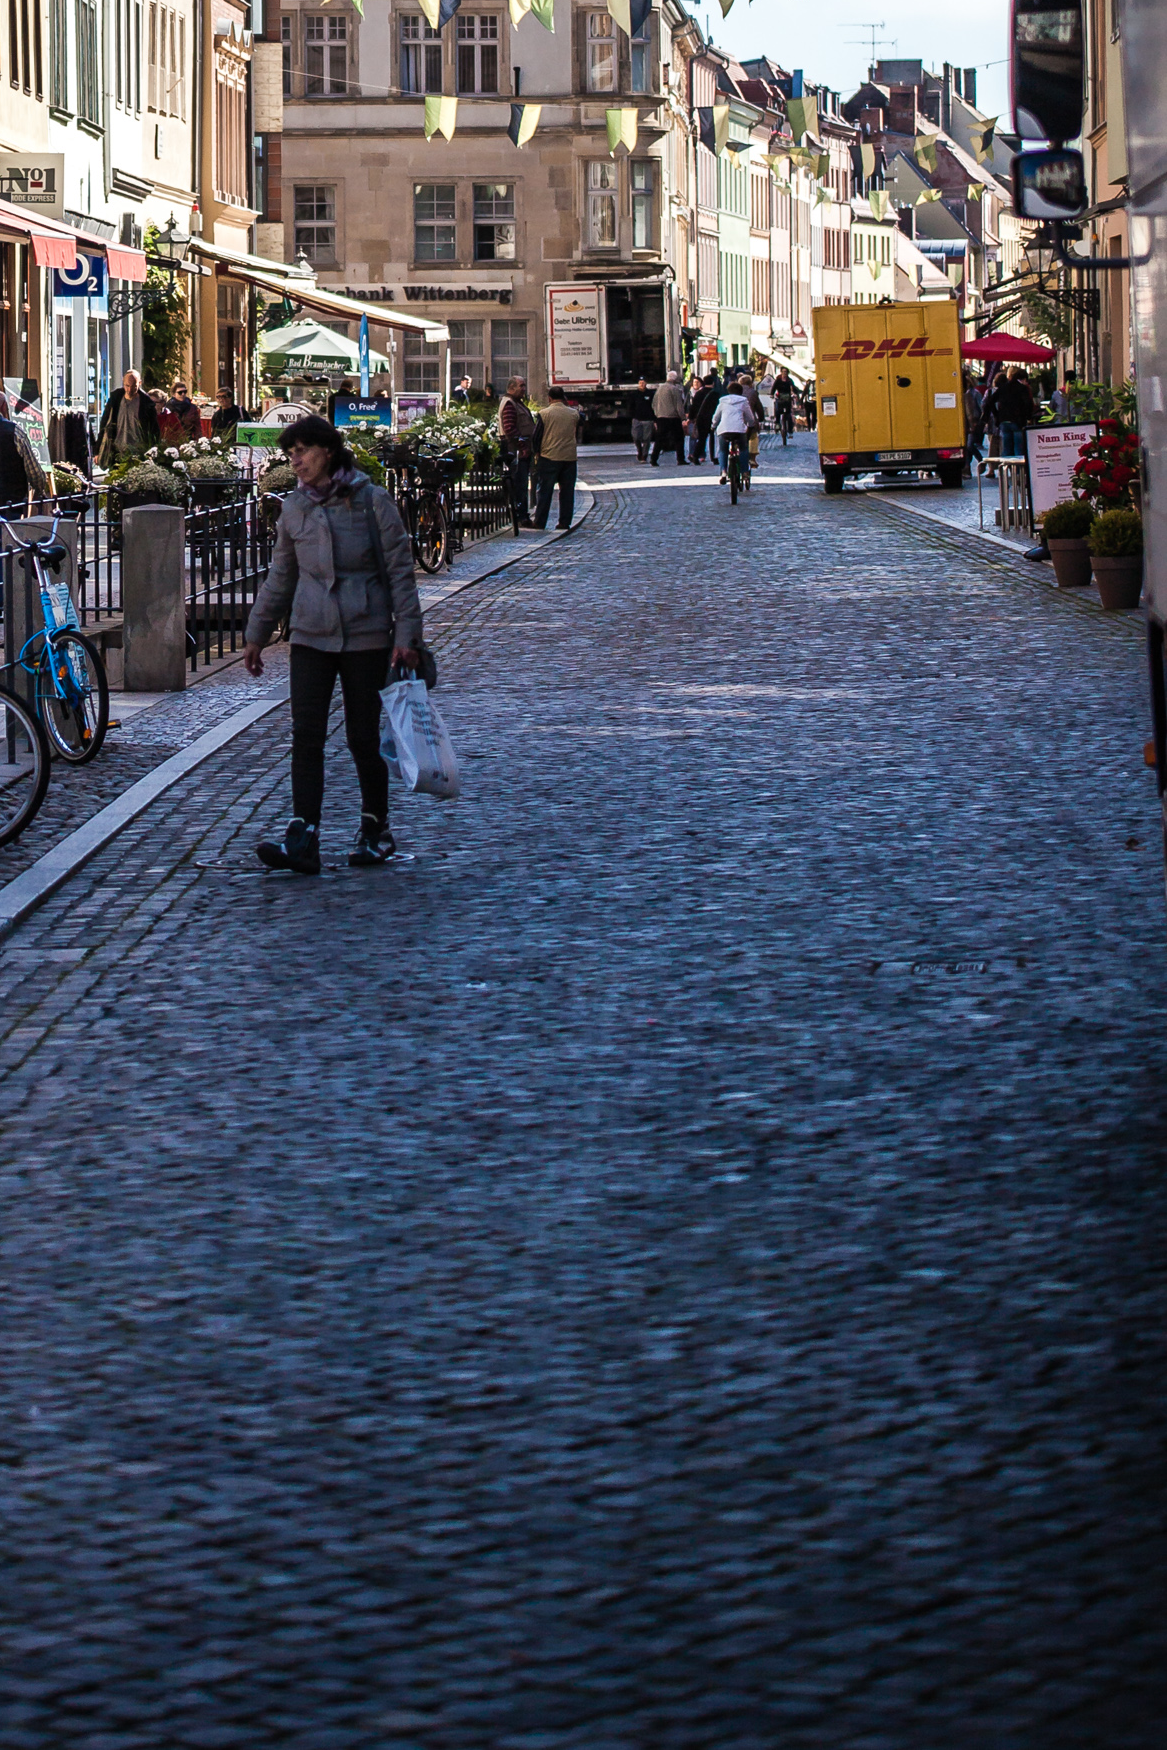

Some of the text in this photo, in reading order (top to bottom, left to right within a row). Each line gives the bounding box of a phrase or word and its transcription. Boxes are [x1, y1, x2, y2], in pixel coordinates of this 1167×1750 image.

[27, 194, 55, 202] EXPRESS
[58, 253, 98, 292] O2
[403, 286, 512, 304] Wittenberg
[839, 337, 935, 360] DHL
[289, 354, 345, 369] Bad Brambacher
[359, 402, 376, 411] Free
[1037, 432, 1086, 443] Nam King
